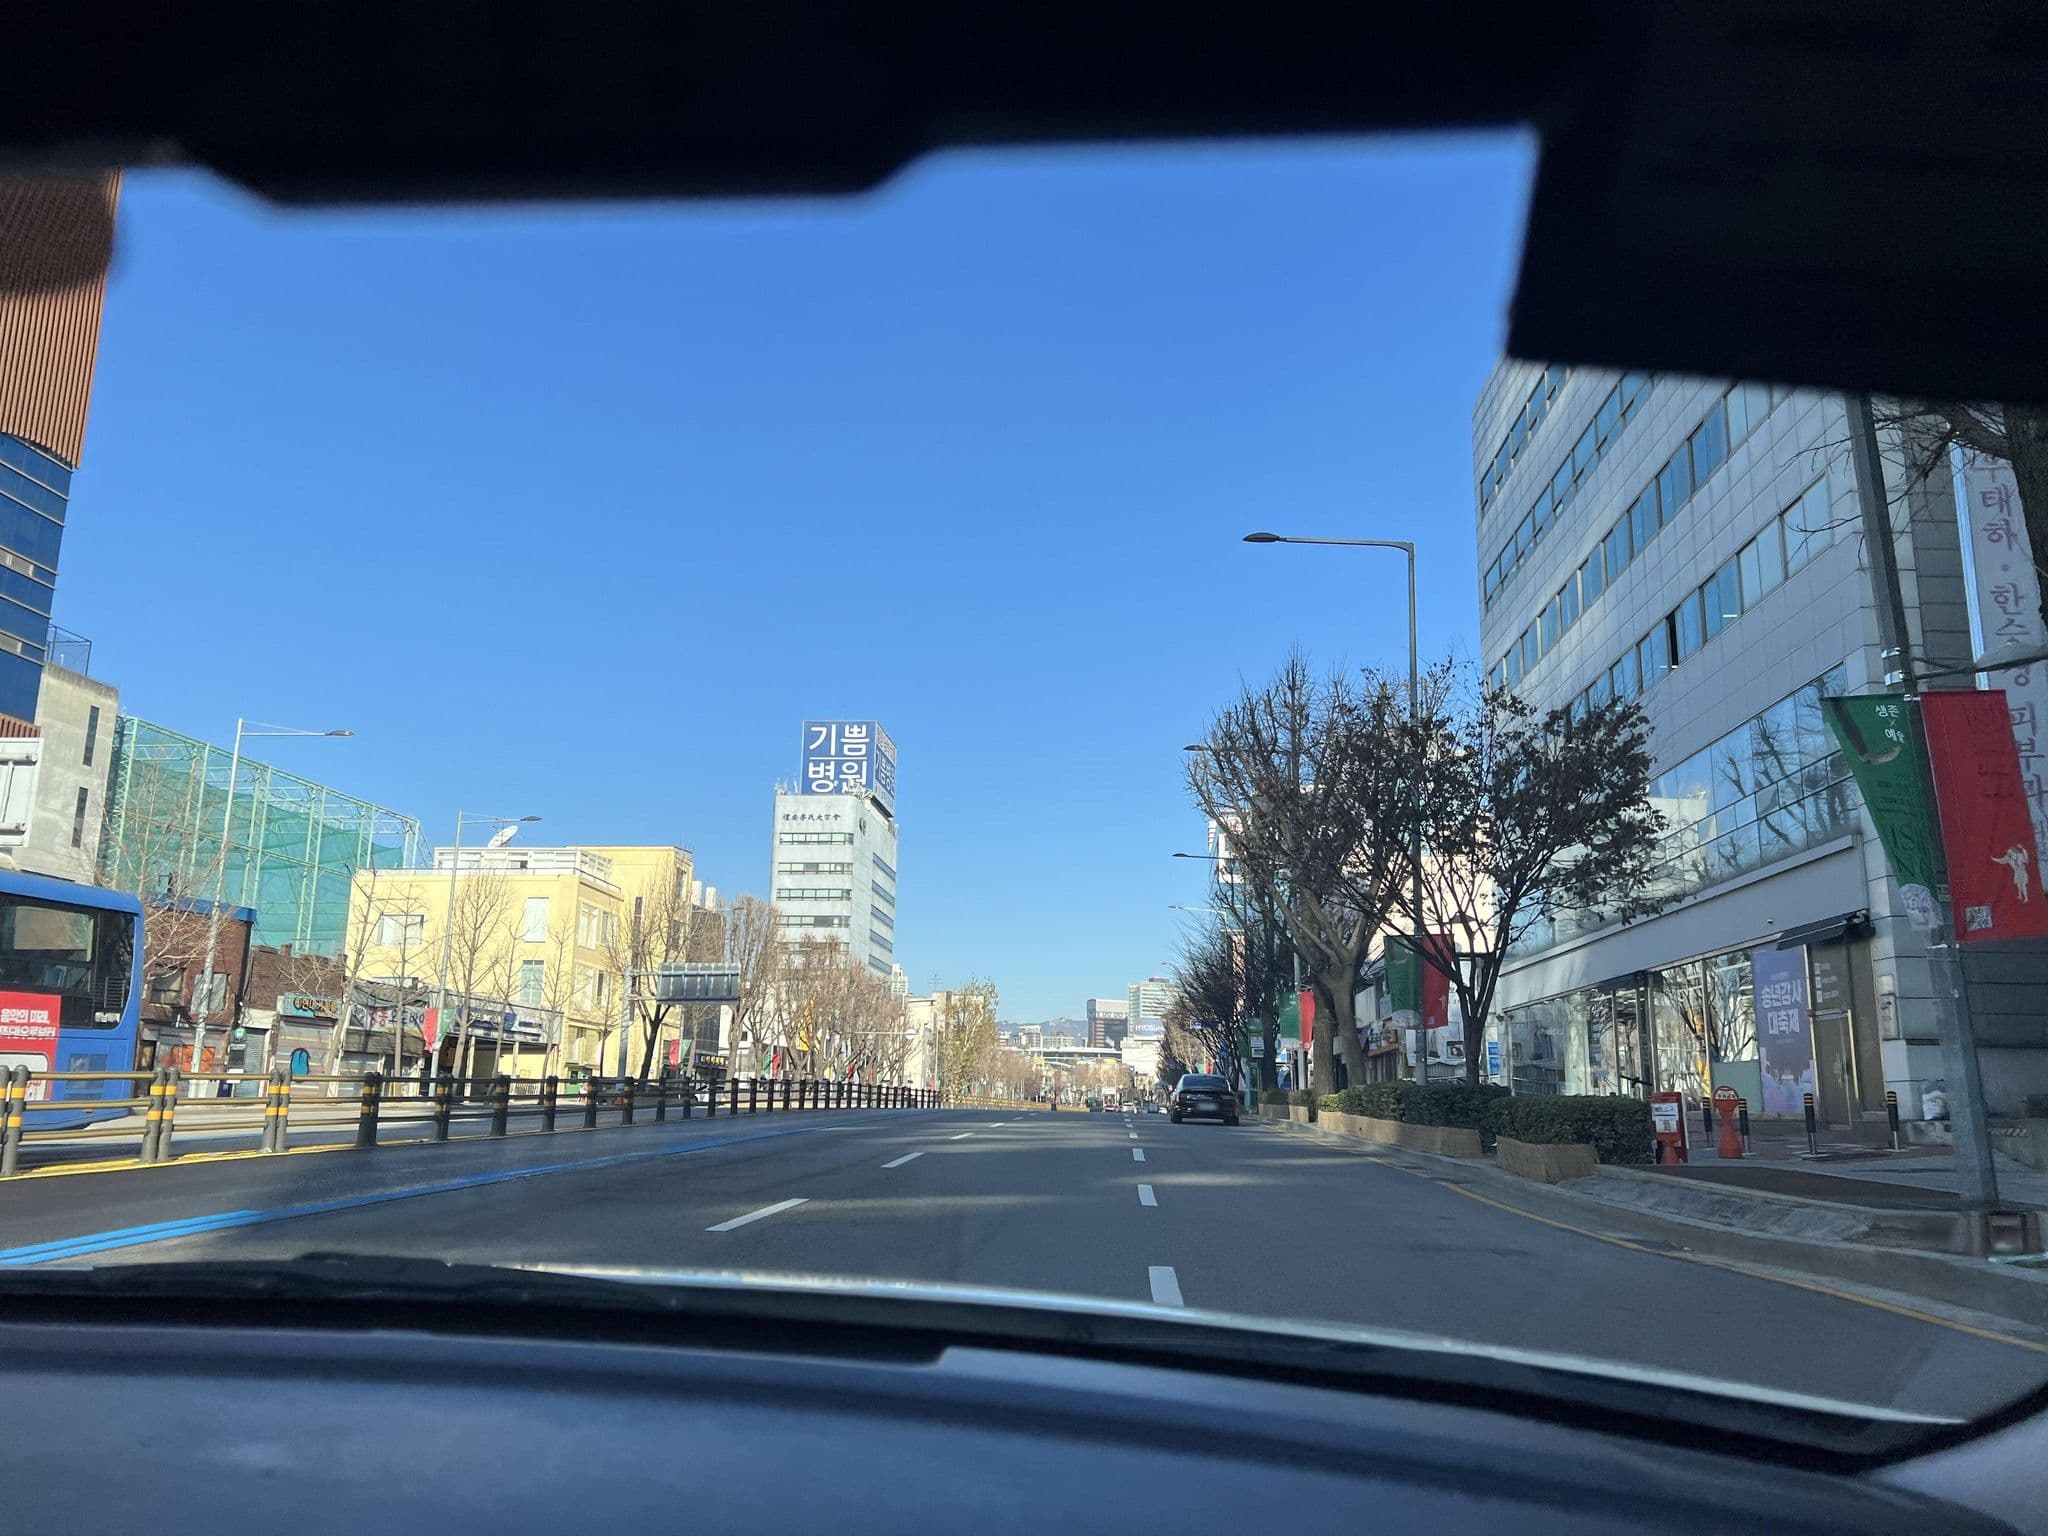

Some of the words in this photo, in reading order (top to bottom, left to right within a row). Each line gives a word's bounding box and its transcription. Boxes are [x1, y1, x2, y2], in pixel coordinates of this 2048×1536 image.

[1875, 704, 1900, 718] 생존
[809, 723, 870, 757] 기쁨
[808, 760, 868, 794] 병원
[1761, 978, 1802, 1009] 송년감사
[1767, 1008, 1800, 1035] 대축제
